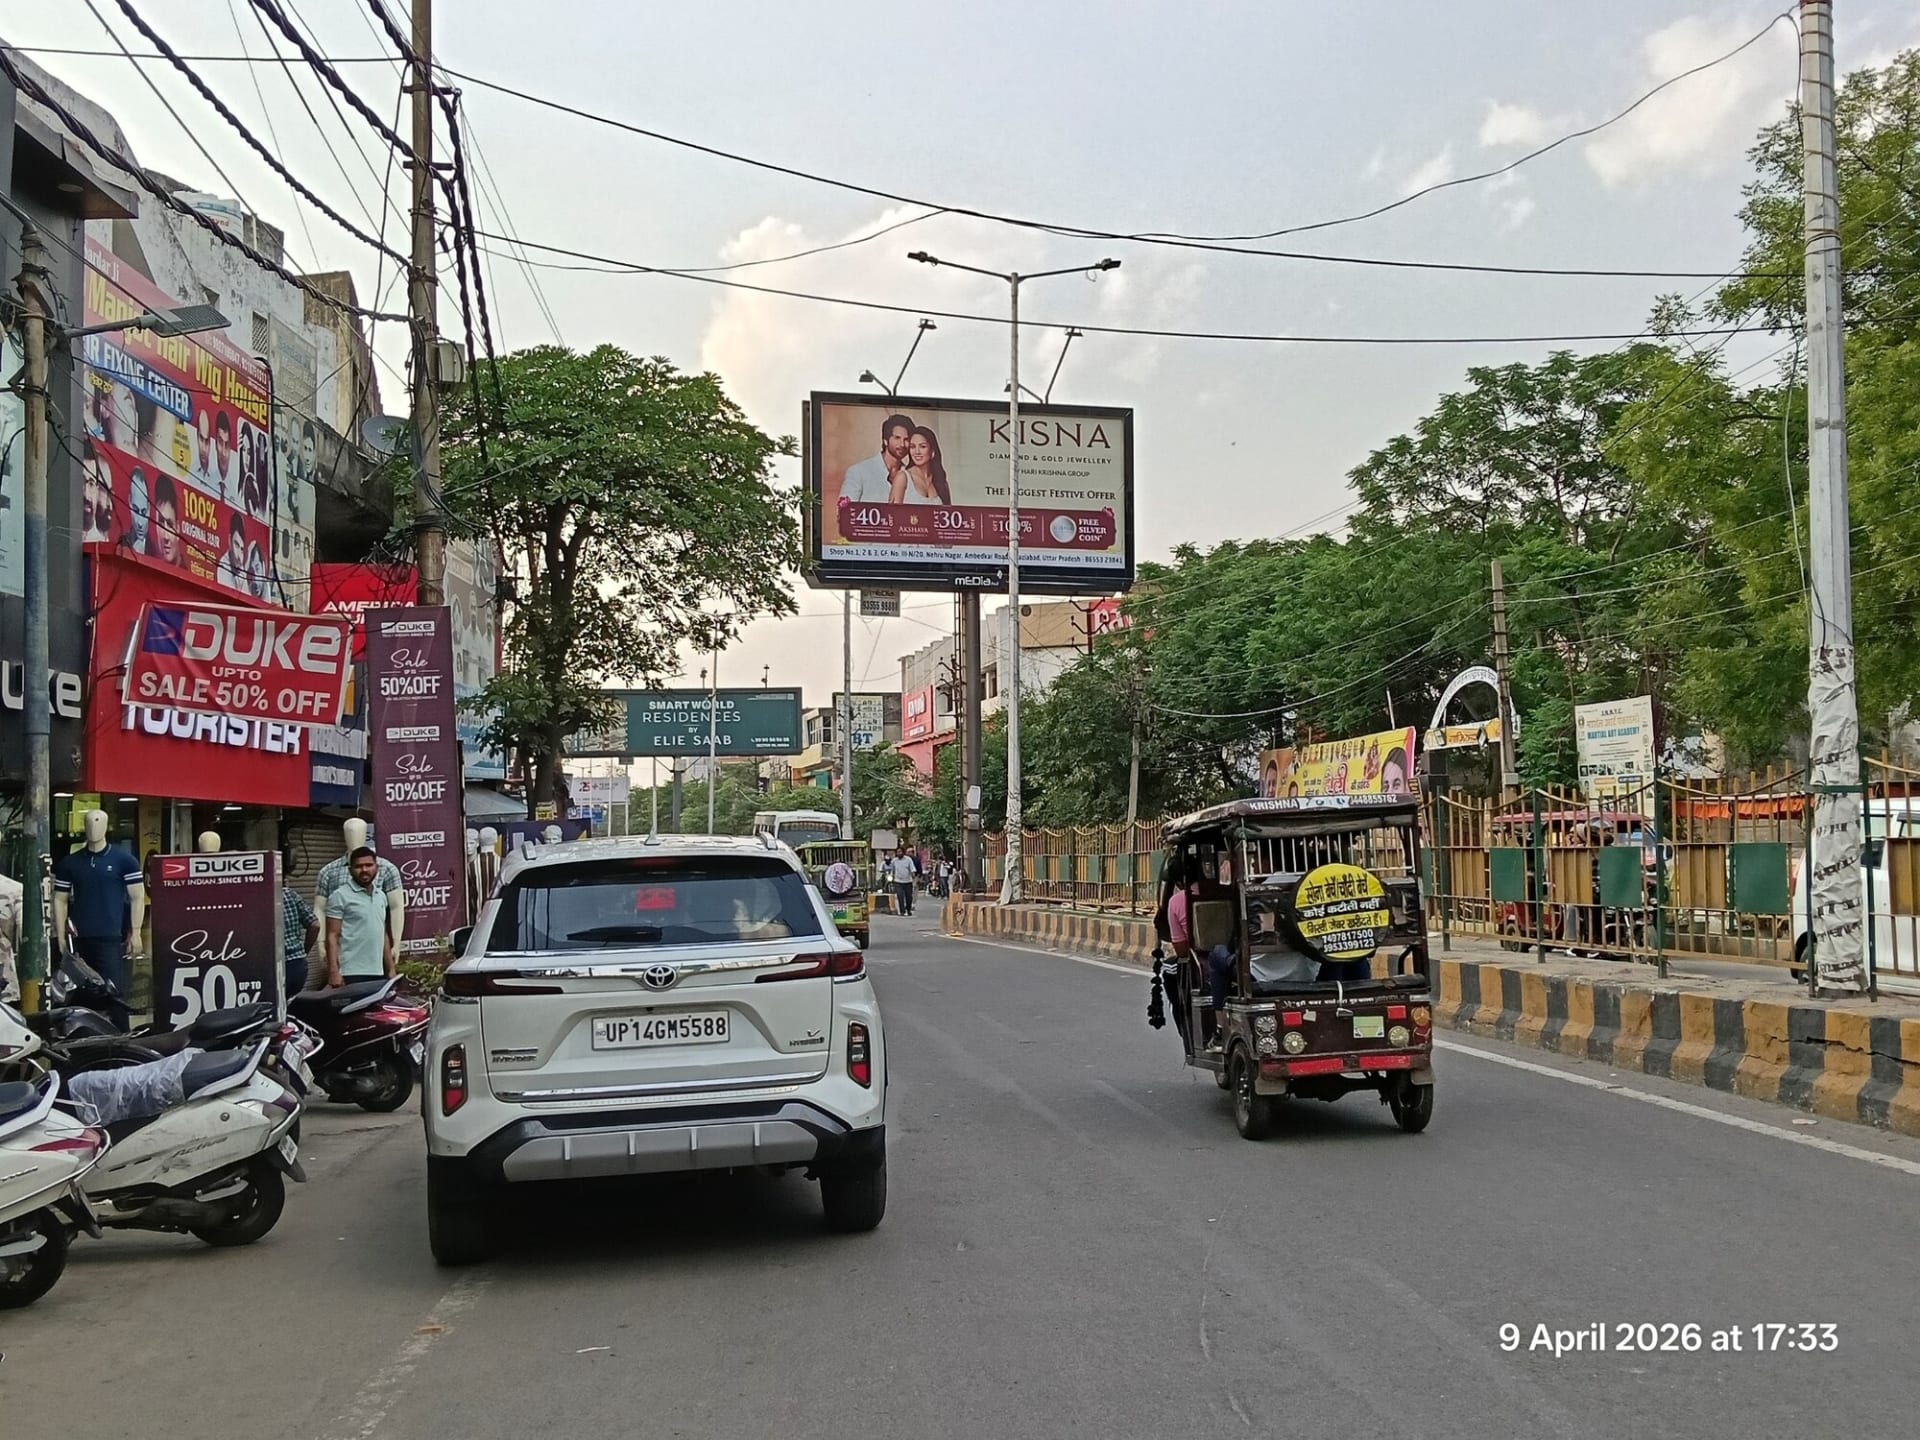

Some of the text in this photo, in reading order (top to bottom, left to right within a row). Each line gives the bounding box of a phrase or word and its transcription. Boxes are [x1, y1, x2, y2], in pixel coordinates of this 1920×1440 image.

[103, 342, 145, 392] FIXING
[148, 370, 189, 419] CENTER
[195, 343, 222, 404] Wig
[225, 366, 267, 425] House
[988, 419, 1111, 449] KISNA
[988, 452, 1030, 461] DIAMND
[1041, 455, 1064, 463] GOLD
[1066, 456, 1112, 465] JEWELLERY
[1038, 469, 1066, 477] KRISHNA
[1067, 470, 1091, 478] GROUP
[985, 486, 1117, 501] THE GGEST FESTIVE OFFER
[184, 488, 217, 531] 100%
[1078, 518, 1100, 526] FREE
[1078, 526, 1107, 535] SILVER
[829, 547, 844, 556] Shop
[964, 551, 993, 560] Ambedkar
[1058, 555, 1081, 563] Pradesh
[390, 648, 429, 669] Sale
[138, 670, 332, 717] SALE 50% OFF
[653, 735, 732, 746] ELIE SAAB
[395, 753, 434, 774] Sale
[1249, 799, 1299, 811] KRISHNA
[400, 859, 439, 880] Sale
[163, 879, 187, 887] TRULY
[244, 875, 264, 883] 1966
[1303, 905, 1326, 918] कोई
[1359, 897, 1380, 910] नहीं
[170, 929, 247, 964] Sale
[606, 1017, 727, 1042] UP14GM5588
